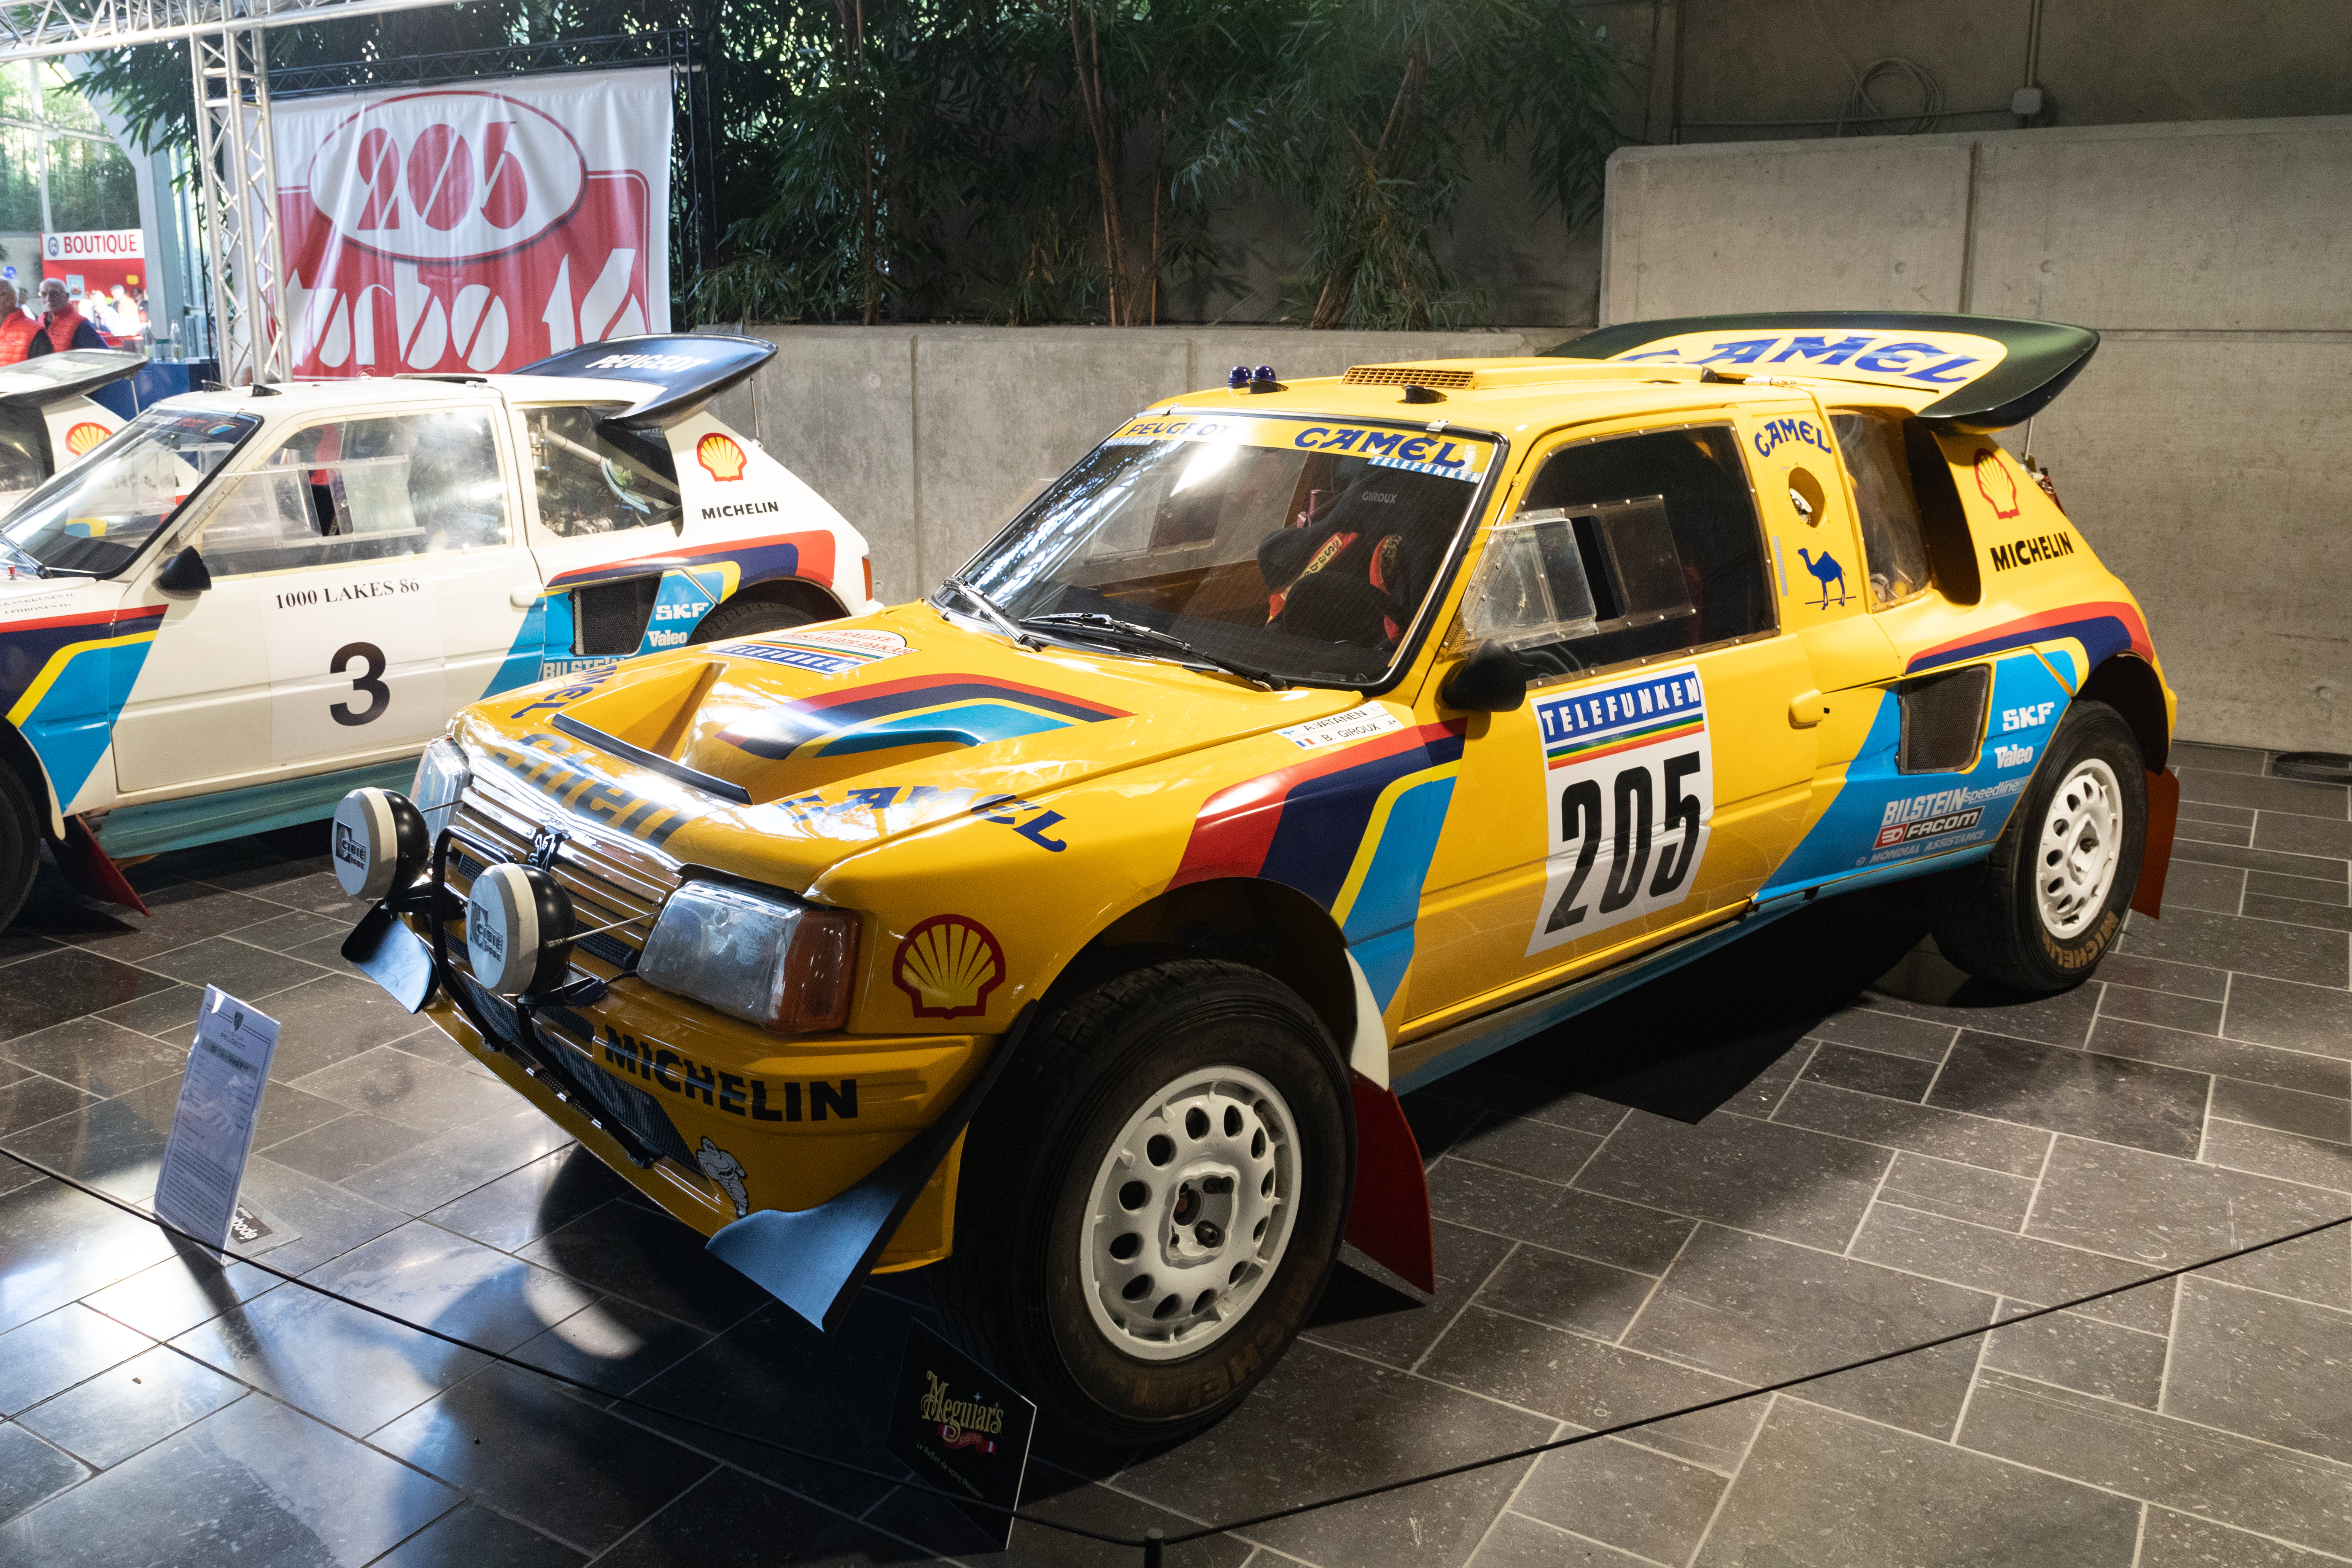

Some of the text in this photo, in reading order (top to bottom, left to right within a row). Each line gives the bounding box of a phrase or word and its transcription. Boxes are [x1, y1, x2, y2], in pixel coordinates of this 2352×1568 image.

[357, 121, 528, 231] 205
[64, 234, 137, 254] BOUTIQUE
[542, 248, 647, 355] 16
[585, 354, 711, 373] PEUGEOT
[1125, 423, 1234, 436] PEUGEOT
[1754, 418, 1832, 457] CAMEL
[1294, 427, 1465, 468] CAMEL
[1372, 456, 1482, 483] TELEFUNKEN
[701, 501, 779, 520] MICHELIN
[1362, 491, 1397, 504] GIROUX
[1303, 546, 1334, 569] Sabe
[1990, 532, 2074, 571] MICHELIN
[0, 594, 64, 606] .KANKKUNEN
[276, 578, 420, 609] 1000 LAKES 86
[656, 602, 711, 620] SKF
[648, 630, 687, 647] Valeo
[780, 633, 914, 655] ARIS-ALGER-DAKAR
[840, 632, 896, 642] RALLYE
[718, 644, 857, 671] ELEFUNKEN
[330, 642, 390, 726] 3
[1541, 677, 1700, 736] TELEFUNKEN
[2002, 702, 2055, 731] SKF
[1303, 710, 1368, 731] A.VATANEN
[1338, 723, 1381, 737] GIROUX
[1994, 744, 2033, 769] Valeo
[1881, 780, 2020, 826] BILSTEIN speedline
[776, 786, 1067, 852] CAMEL
[1906, 812, 1978, 838] FACOM
[1544, 751, 1701, 935] 205
[1870, 830, 1986, 863] MONDIAL ASSISTANCE
[221, 1032, 246, 1050] PEUGEOT
[604, 1024, 858, 1121] MICHELIN
[921, 1370, 1004, 1442] Meguiar's
[972, 1434, 982, 1444] 1901
[916, 1441, 983, 1499] Le Reflet de votre Passion
